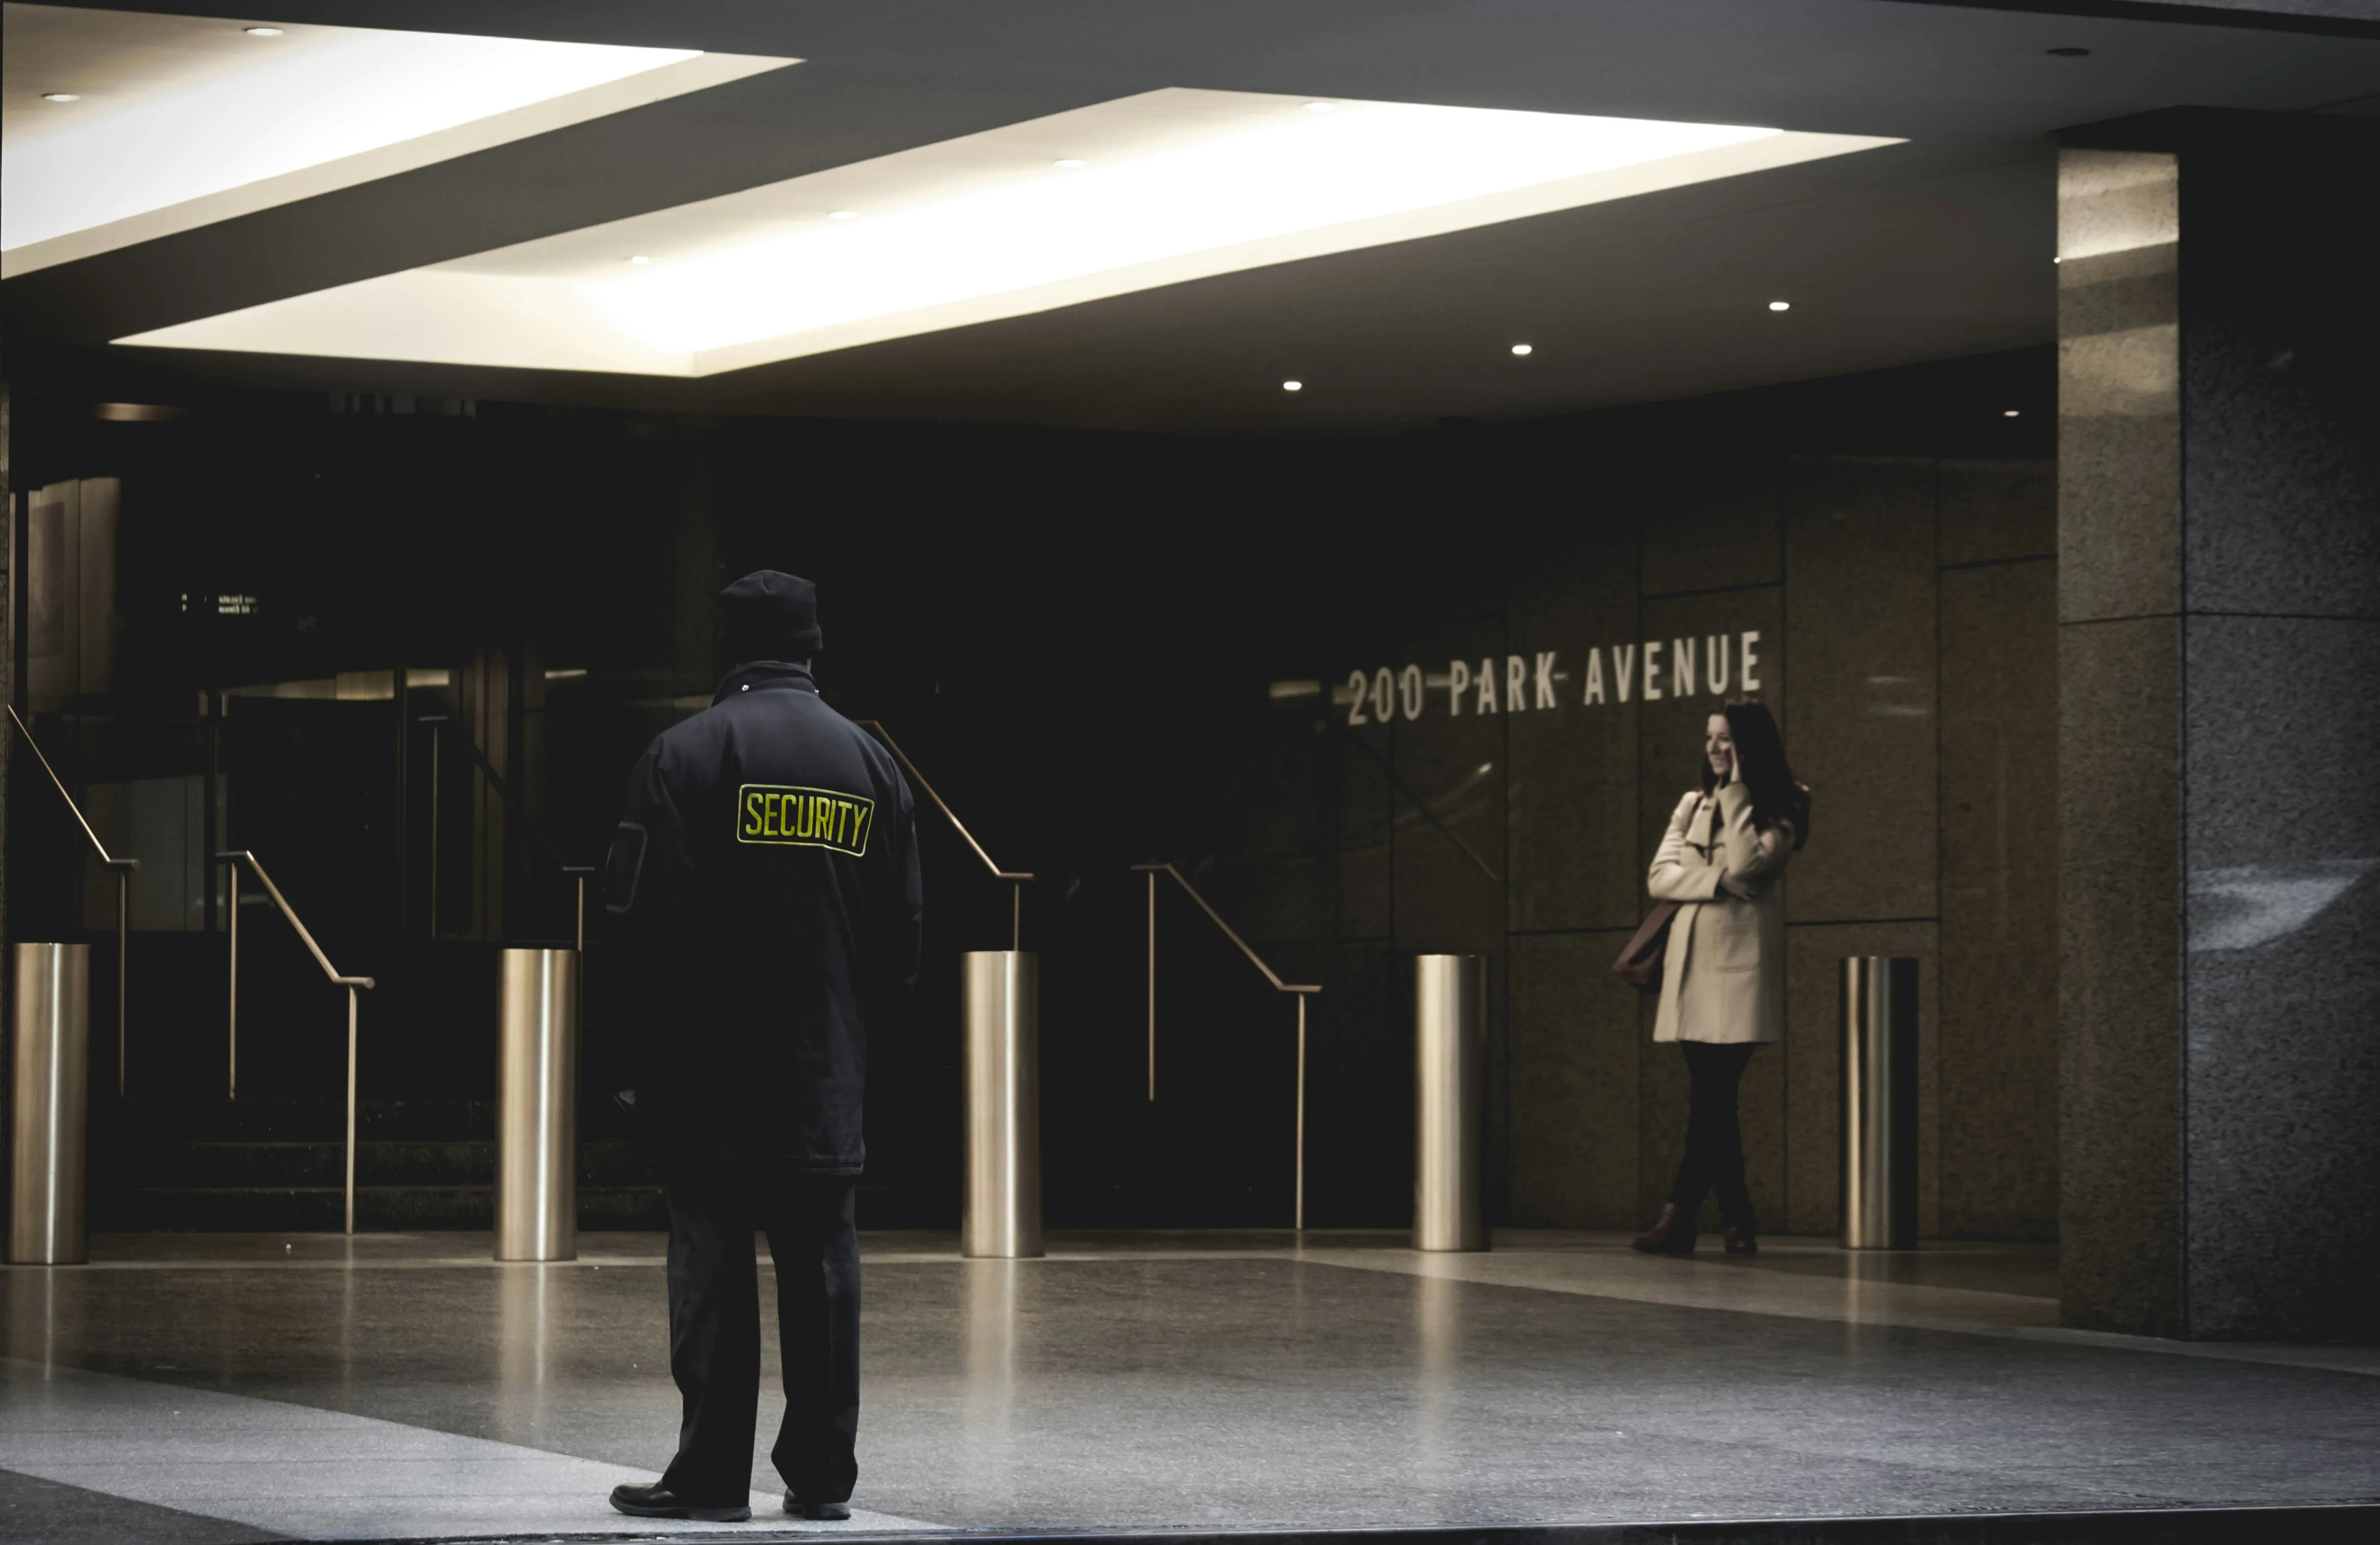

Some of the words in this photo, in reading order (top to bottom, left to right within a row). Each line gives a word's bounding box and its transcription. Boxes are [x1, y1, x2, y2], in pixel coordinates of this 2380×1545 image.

[1348, 664, 1423, 726] 200
[1450, 651, 1556, 716] PARK
[1584, 631, 1760, 705] AVENUE
[745, 793, 868, 847] SECURITY
